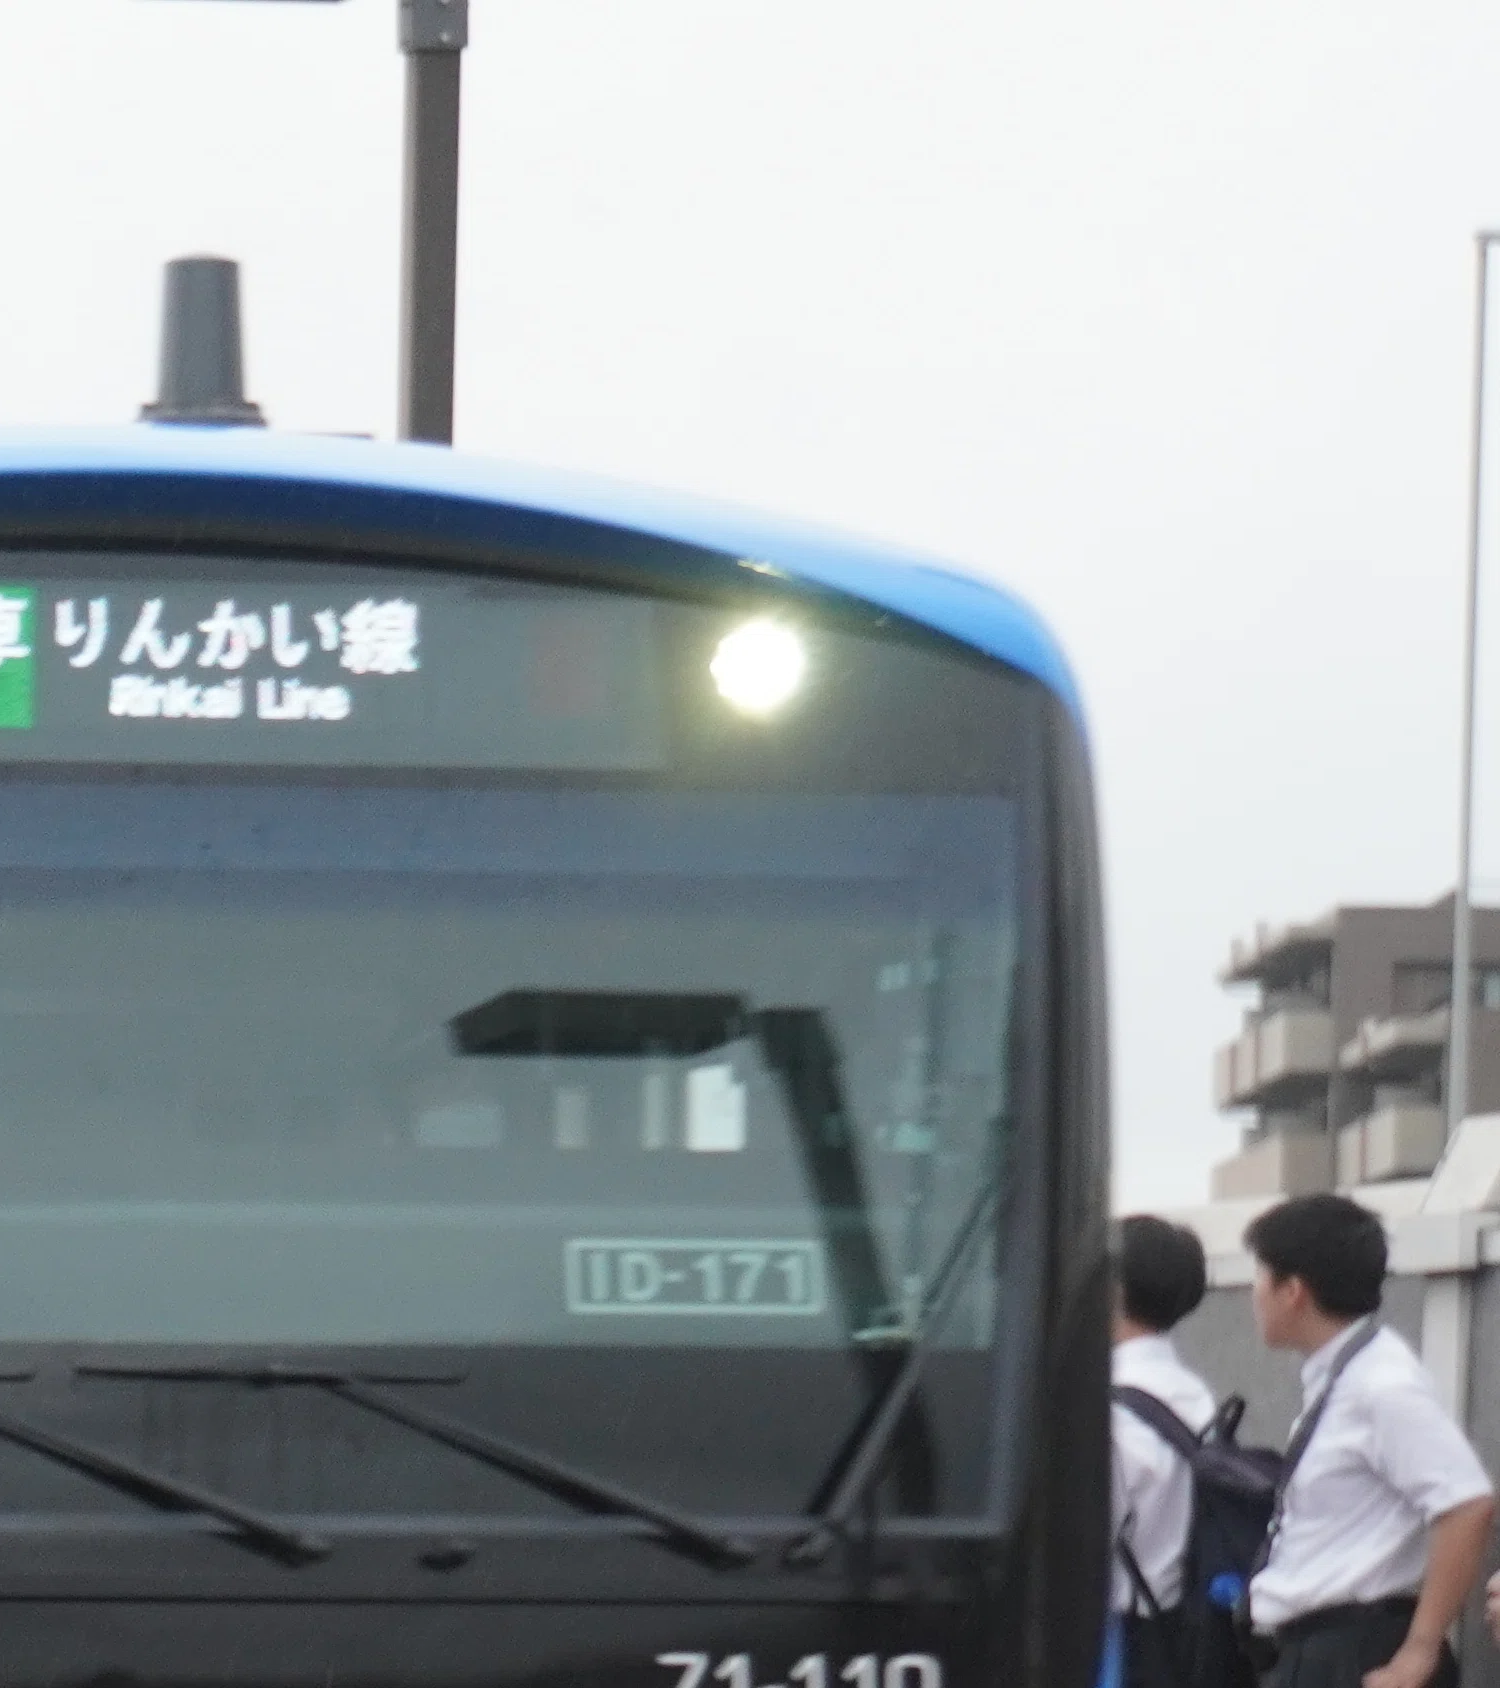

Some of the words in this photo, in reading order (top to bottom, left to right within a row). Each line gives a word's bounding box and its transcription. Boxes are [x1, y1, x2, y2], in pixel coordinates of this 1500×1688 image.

[54, 597, 419, 673] りんかい線
[108, 676, 244, 717] Rinkai
[257, 677, 351, 720] Line
[589, 1253, 805, 1303] ID-171
